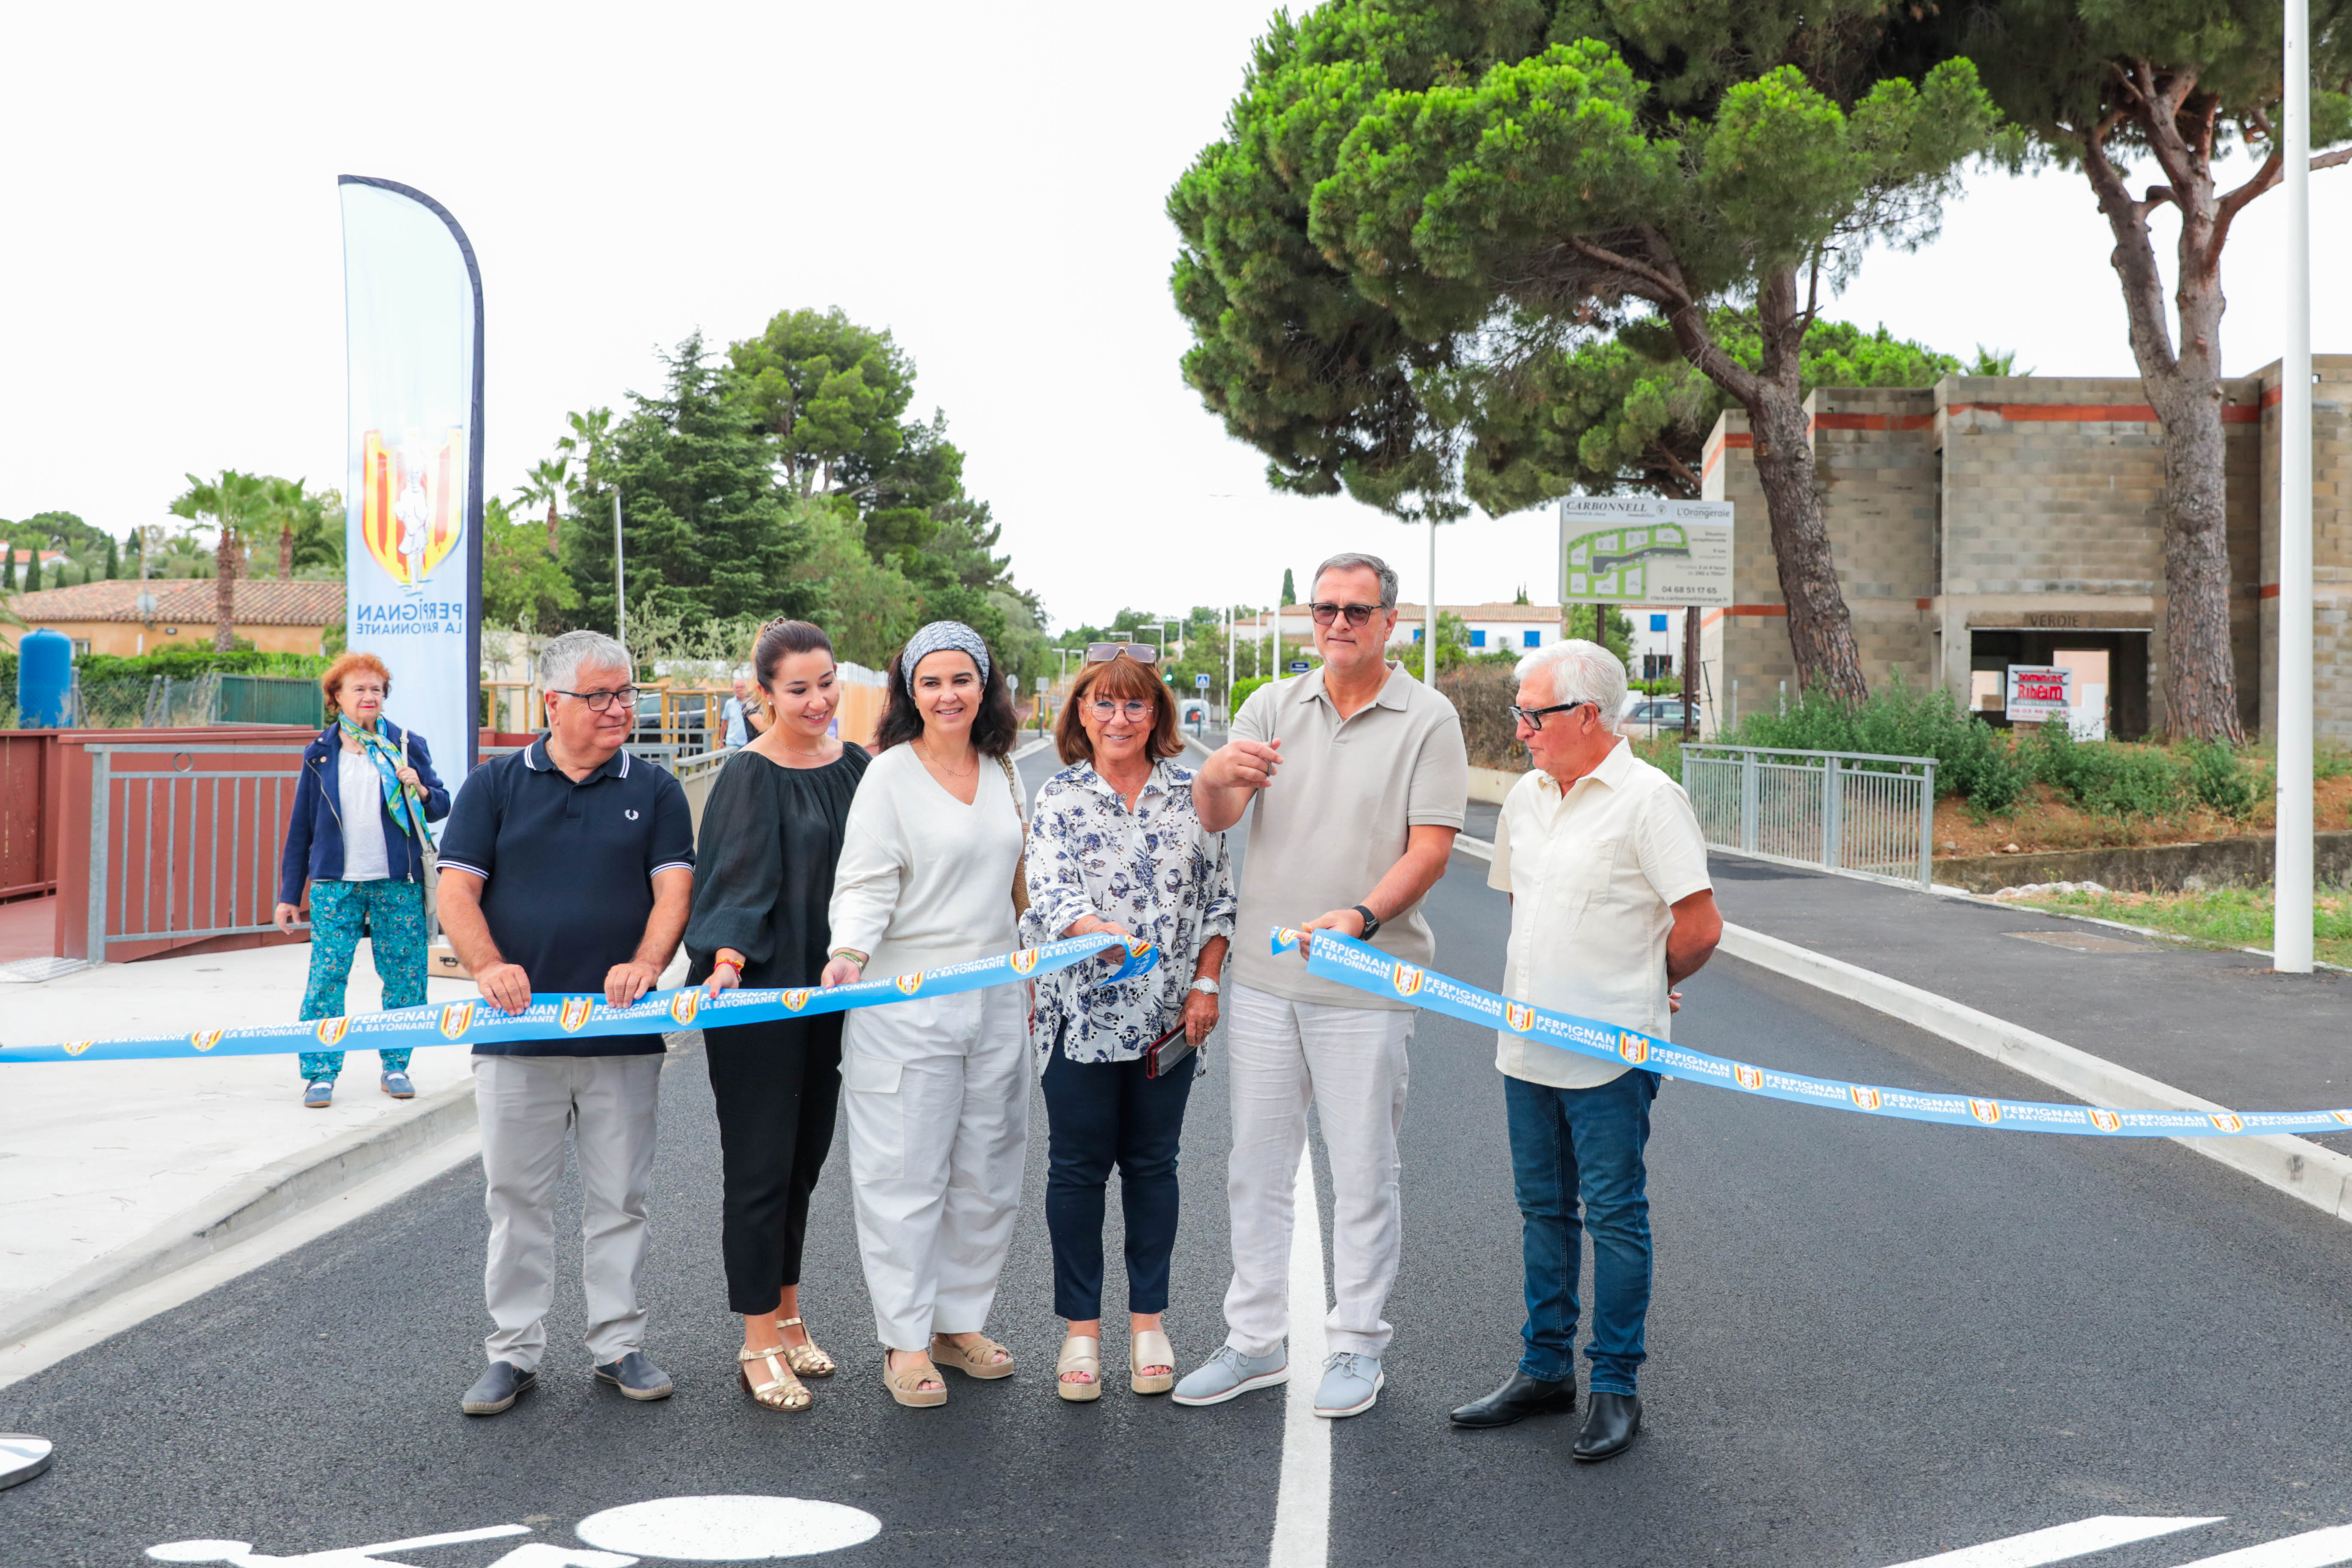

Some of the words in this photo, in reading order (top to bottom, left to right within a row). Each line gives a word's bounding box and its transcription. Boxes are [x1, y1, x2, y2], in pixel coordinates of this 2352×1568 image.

[1567, 501, 1647, 512] CARBONNELL
[1677, 508, 1730, 519] L'Orangeraie
[2030, 615, 2079, 627] VERDIE
[1056, 936, 1120, 956] RAYONNANTE
[1314, 935, 1390, 972] PERPIGNAN
[941, 960, 1005, 977] RAYONNANTE
[1312, 947, 1322, 957] LA
[1325, 952, 1389, 979] RAYONNANTE
[826, 979, 891, 994] RAYONNANTE
[1425, 976, 1502, 1010] PERPIGNAN
[700, 1002, 711, 1010] LA
[714, 996, 777, 1009] RAYONNANTE
[701, 992, 780, 1001] PRPIGNAN
[1423, 985, 1435, 994] LA
[1438, 990, 1501, 1017] RAYONNANTE
[352, 1010, 439, 1024] PERPIGNAN
[475, 1004, 558, 1018] PERPNAN
[606, 1008, 667, 1020] RAYONNANTE
[366, 1022, 435, 1032] RAYONNANTE
[488, 1016, 555, 1025] RAYONNANTE
[241, 1027, 313, 1037] RAYONNANTE
[1537, 1015, 1615, 1046] PERPIGNAN
[114, 1034, 186, 1043] RAYONNANTE
[1536, 1024, 1547, 1032] LA
[1550, 1028, 1615, 1052] RAYONNANTE
[1651, 1046, 1730, 1072] PERPIGNAN
[1665, 1059, 1730, 1078] RAYONNANTE
[1766, 1074, 1846, 1095] PERPIGNAN
[1781, 1085, 1847, 1101] RAYONNANTE
[1883, 1093, 1966, 1108] PERPIGNAN
[1899, 1102, 1966, 1114] RAYONNANTE
[2002, 1105, 2085, 1118] PERPIGNAN
[2019, 1114, 2087, 1124] RAYONNANTE
